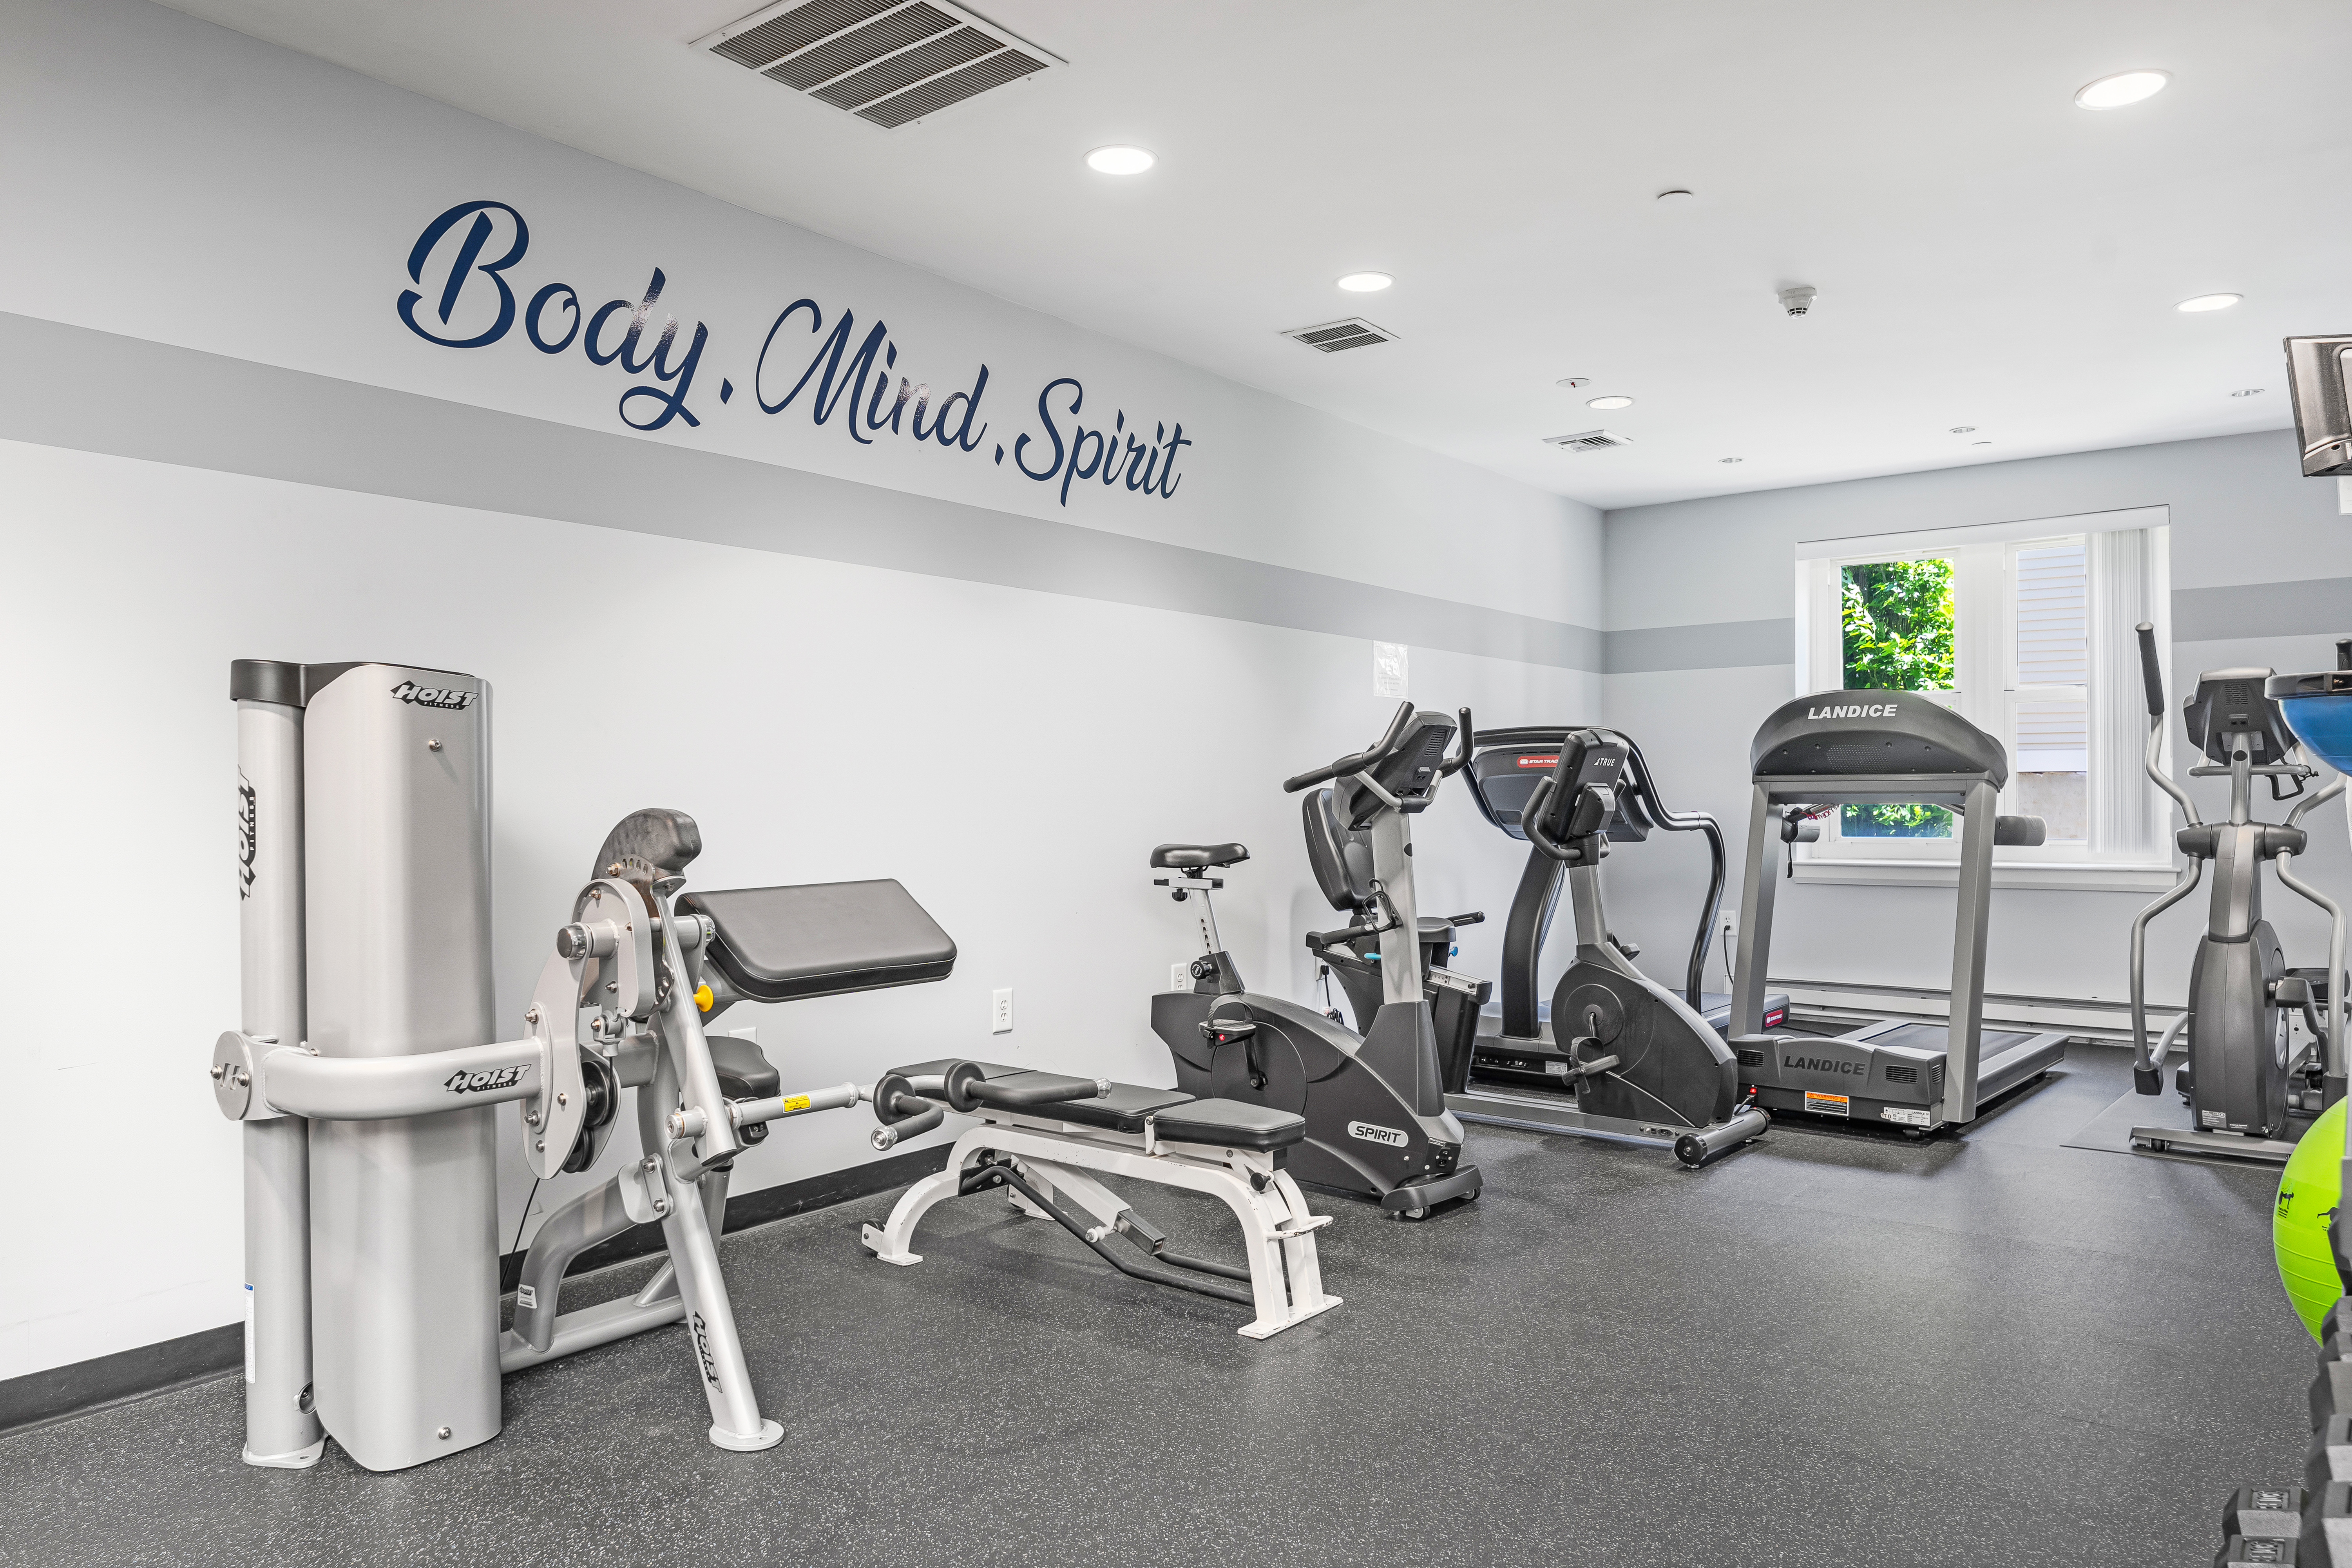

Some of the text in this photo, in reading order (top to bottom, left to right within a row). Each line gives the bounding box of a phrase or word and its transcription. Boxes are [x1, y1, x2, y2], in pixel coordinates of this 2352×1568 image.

[1015, 378, 1191, 507] Spirit
[393, 684, 478, 706] HOIST
[1807, 704, 1898, 719] LANDICE
[1601, 758, 1615, 766] TRUE
[1784, 1055, 1865, 1075] LANDICE
[446, 1064, 531, 1091] HOIST
[477, 1082, 512, 1090] FITNESS
[1355, 1126, 1401, 1143] SPIRIT
[693, 1315, 723, 1393] HOIST
